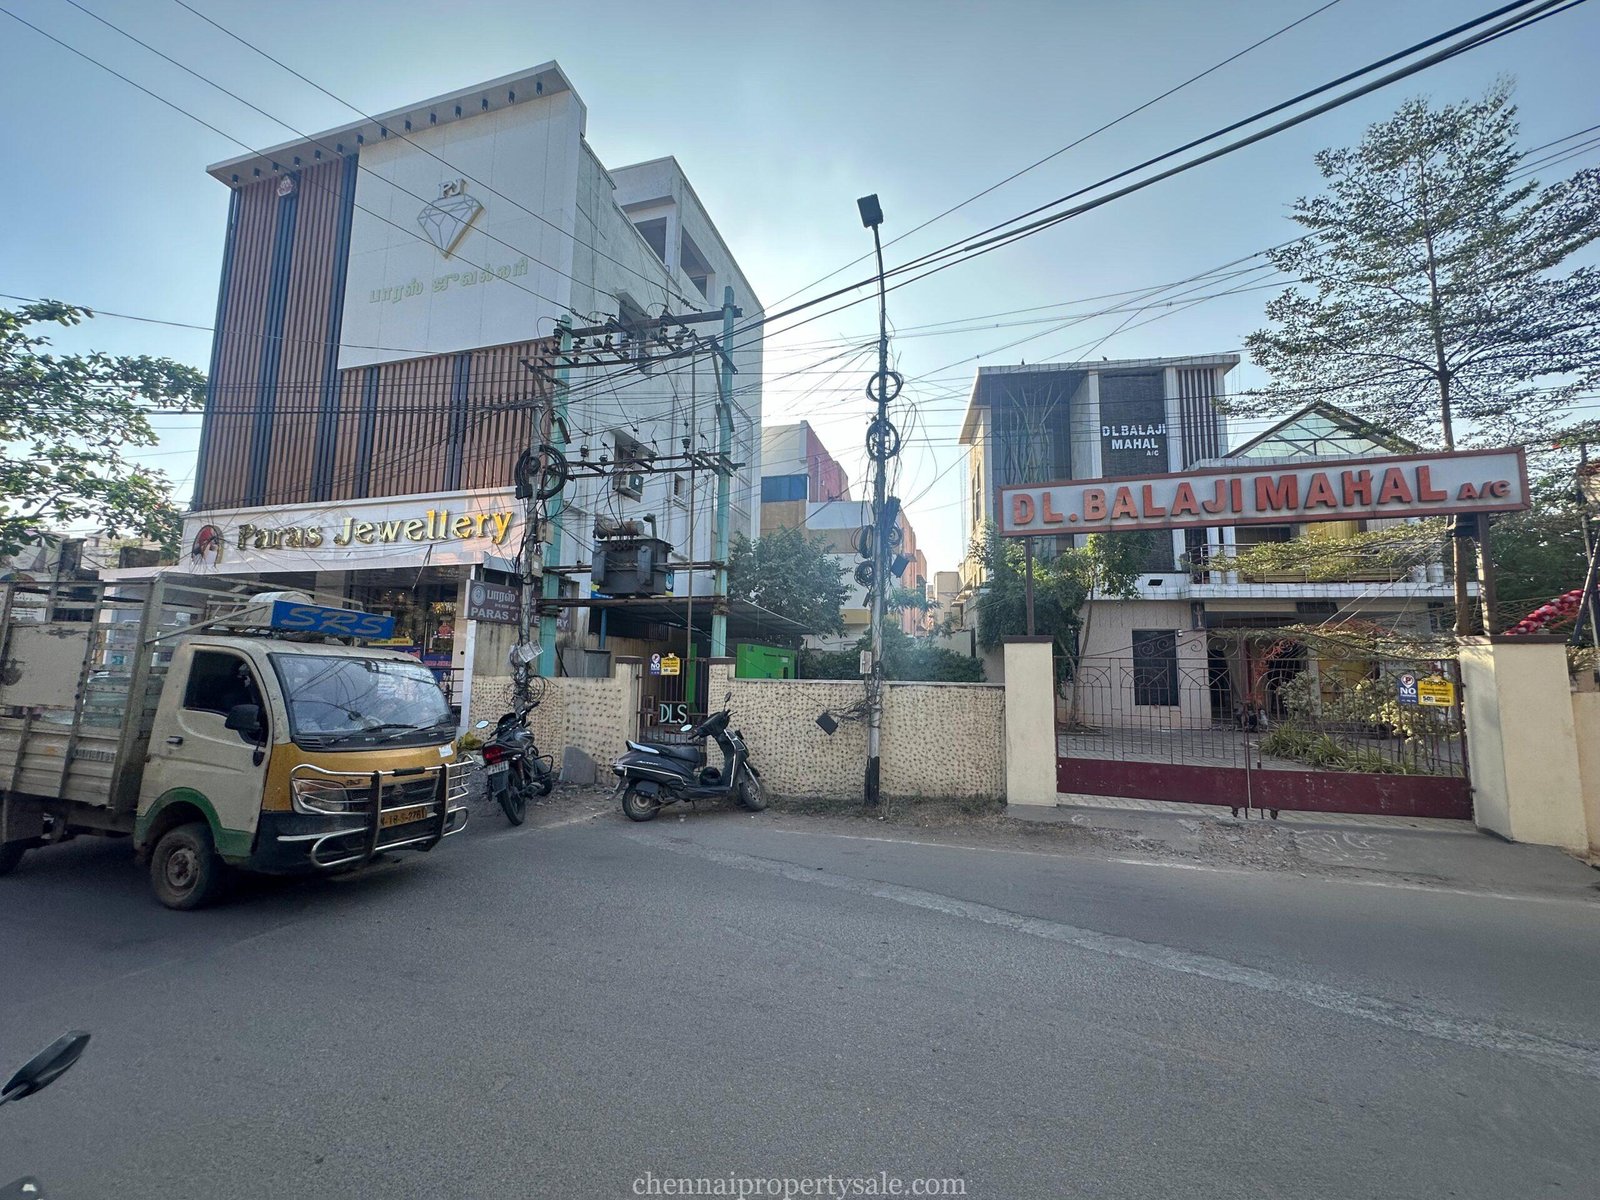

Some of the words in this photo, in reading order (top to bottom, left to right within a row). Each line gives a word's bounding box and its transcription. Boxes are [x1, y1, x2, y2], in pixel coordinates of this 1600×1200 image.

[438, 177, 466, 199] PJ
[1111, 438, 1159, 450] MAHAL
[1254, 464, 1448, 512] MAHAL
[1456, 479, 1512, 500] A/C
[236, 523, 323, 551] Paras
[332, 509, 514, 546] Jewellery
[281, 607, 388, 634] SRS
[470, 607, 509, 621] PARAS
[1400, 687, 1417, 695] NO
[659, 703, 687, 724] DLS
